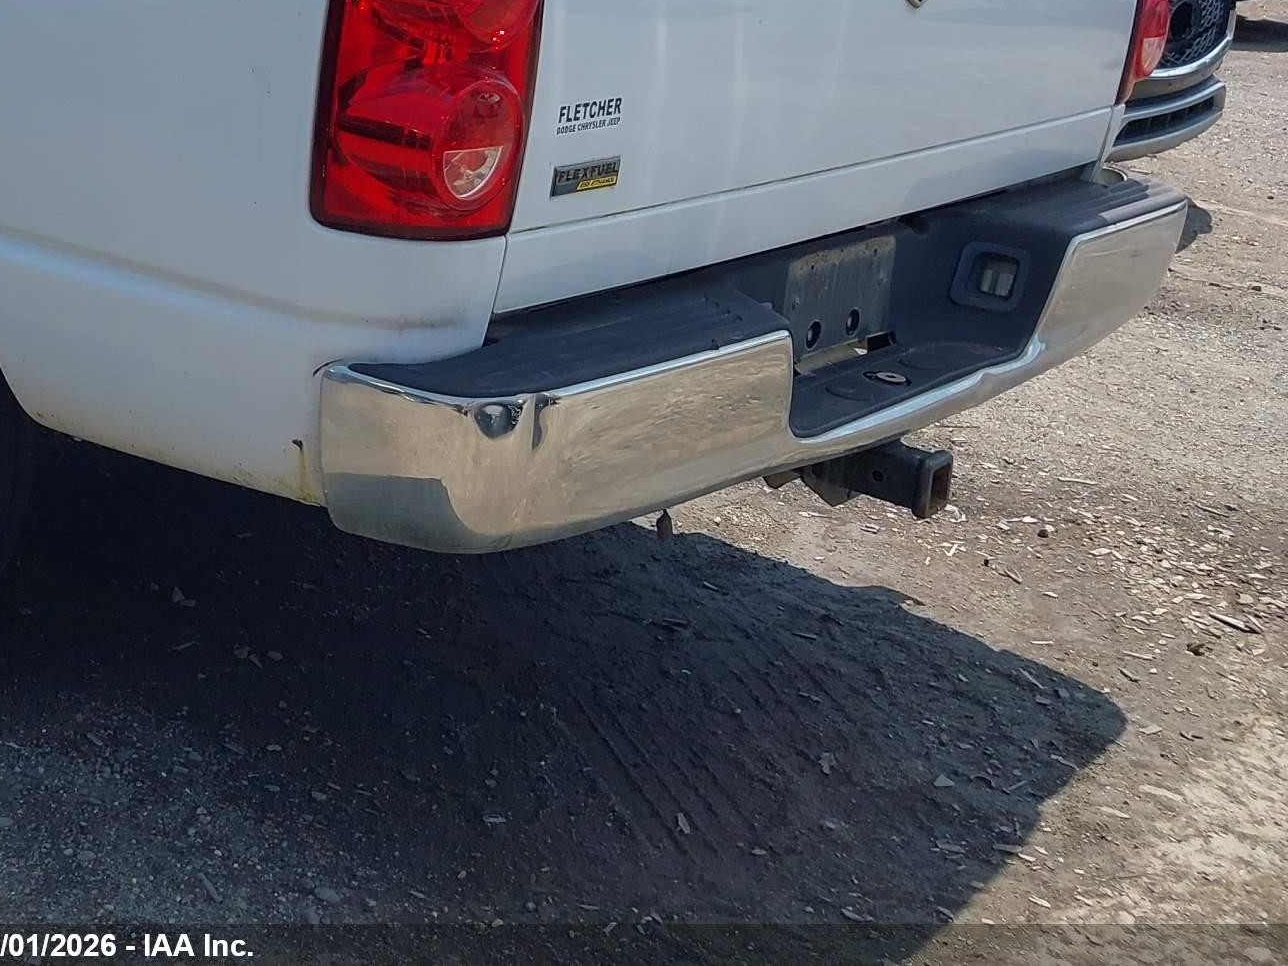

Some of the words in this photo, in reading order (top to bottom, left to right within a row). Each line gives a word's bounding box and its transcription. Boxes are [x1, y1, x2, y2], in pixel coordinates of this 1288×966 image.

[558, 97, 622, 124] FLETCHER
[556, 124, 576, 135] DODGE
[577, 119, 607, 132] CHRYSLER
[607, 116, 621, 127] JEEP
